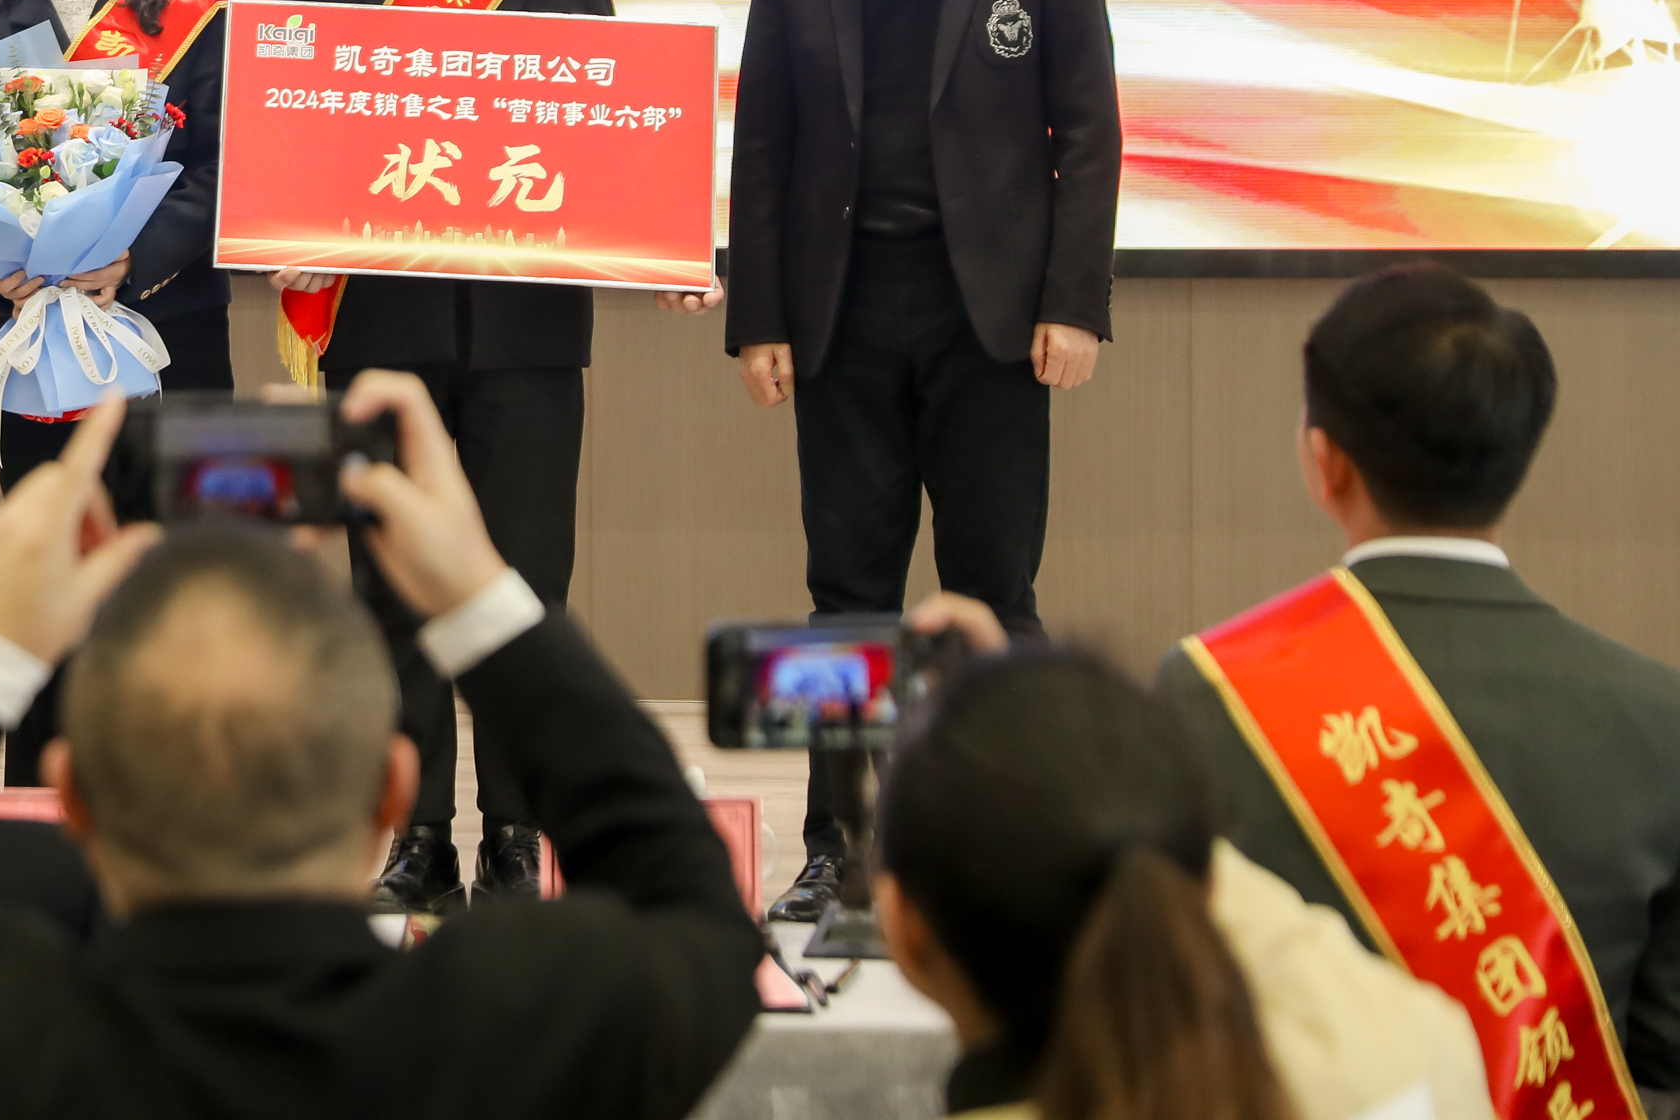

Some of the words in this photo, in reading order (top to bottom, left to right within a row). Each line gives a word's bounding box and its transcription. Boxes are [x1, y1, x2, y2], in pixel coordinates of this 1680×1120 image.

[257, 15, 316, 45] Kaiqi
[256, 43, 315, 59] 凯奇集团
[333, 44, 617, 87] 凯奇集团有限公司
[264, 88, 480, 122] 2024年度销售之星
[369, 138, 565, 213] 状元
